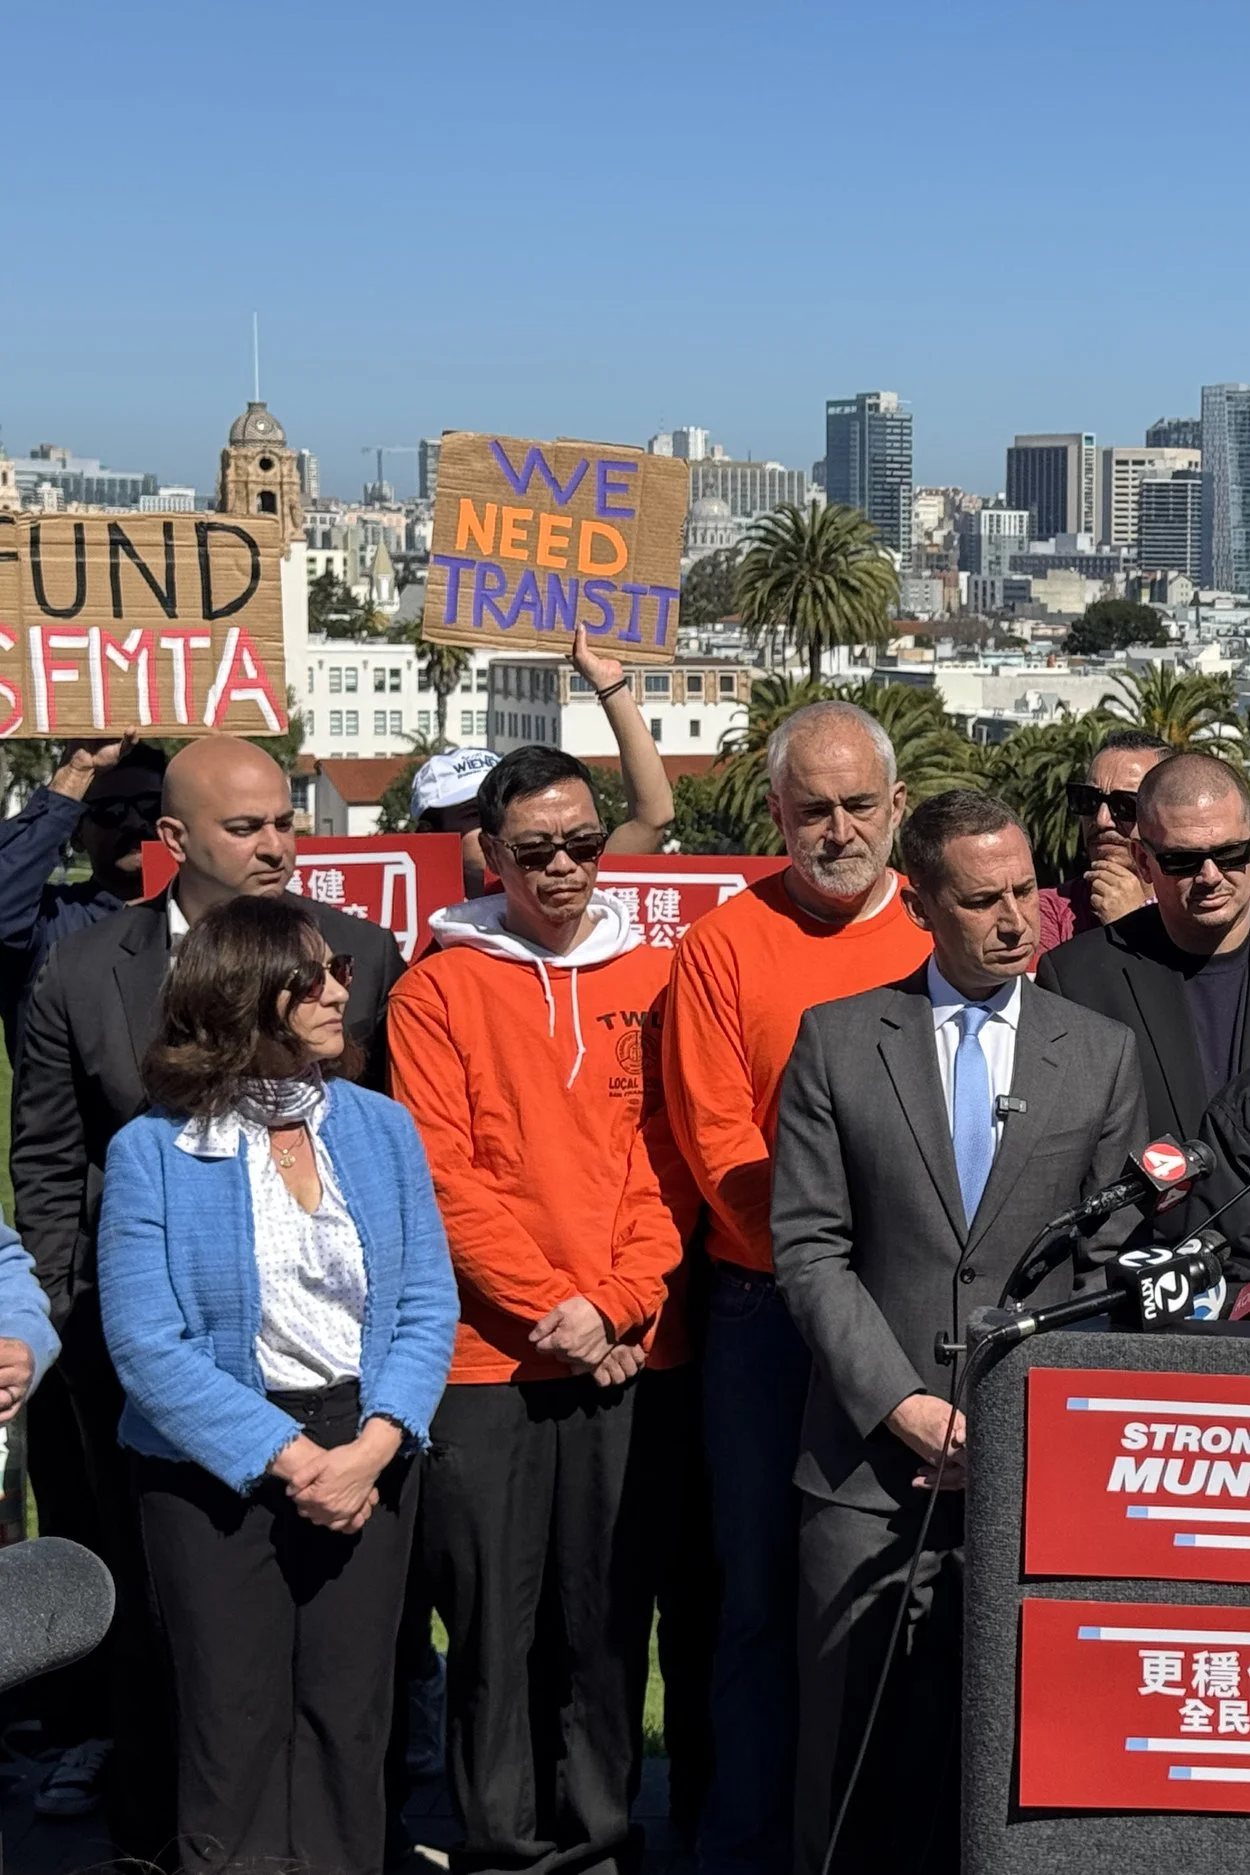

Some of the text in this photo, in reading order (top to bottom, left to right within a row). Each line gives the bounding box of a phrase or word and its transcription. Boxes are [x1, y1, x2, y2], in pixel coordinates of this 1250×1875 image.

[488, 439, 638, 520] WE
[0, 514, 261, 620] UND
[455, 498, 628, 576] NEED
[431, 554, 679, 647] TRANSIT
[609, 1077, 639, 1090] LOCAL
[1141, 1277, 1157, 1320] KTVU
